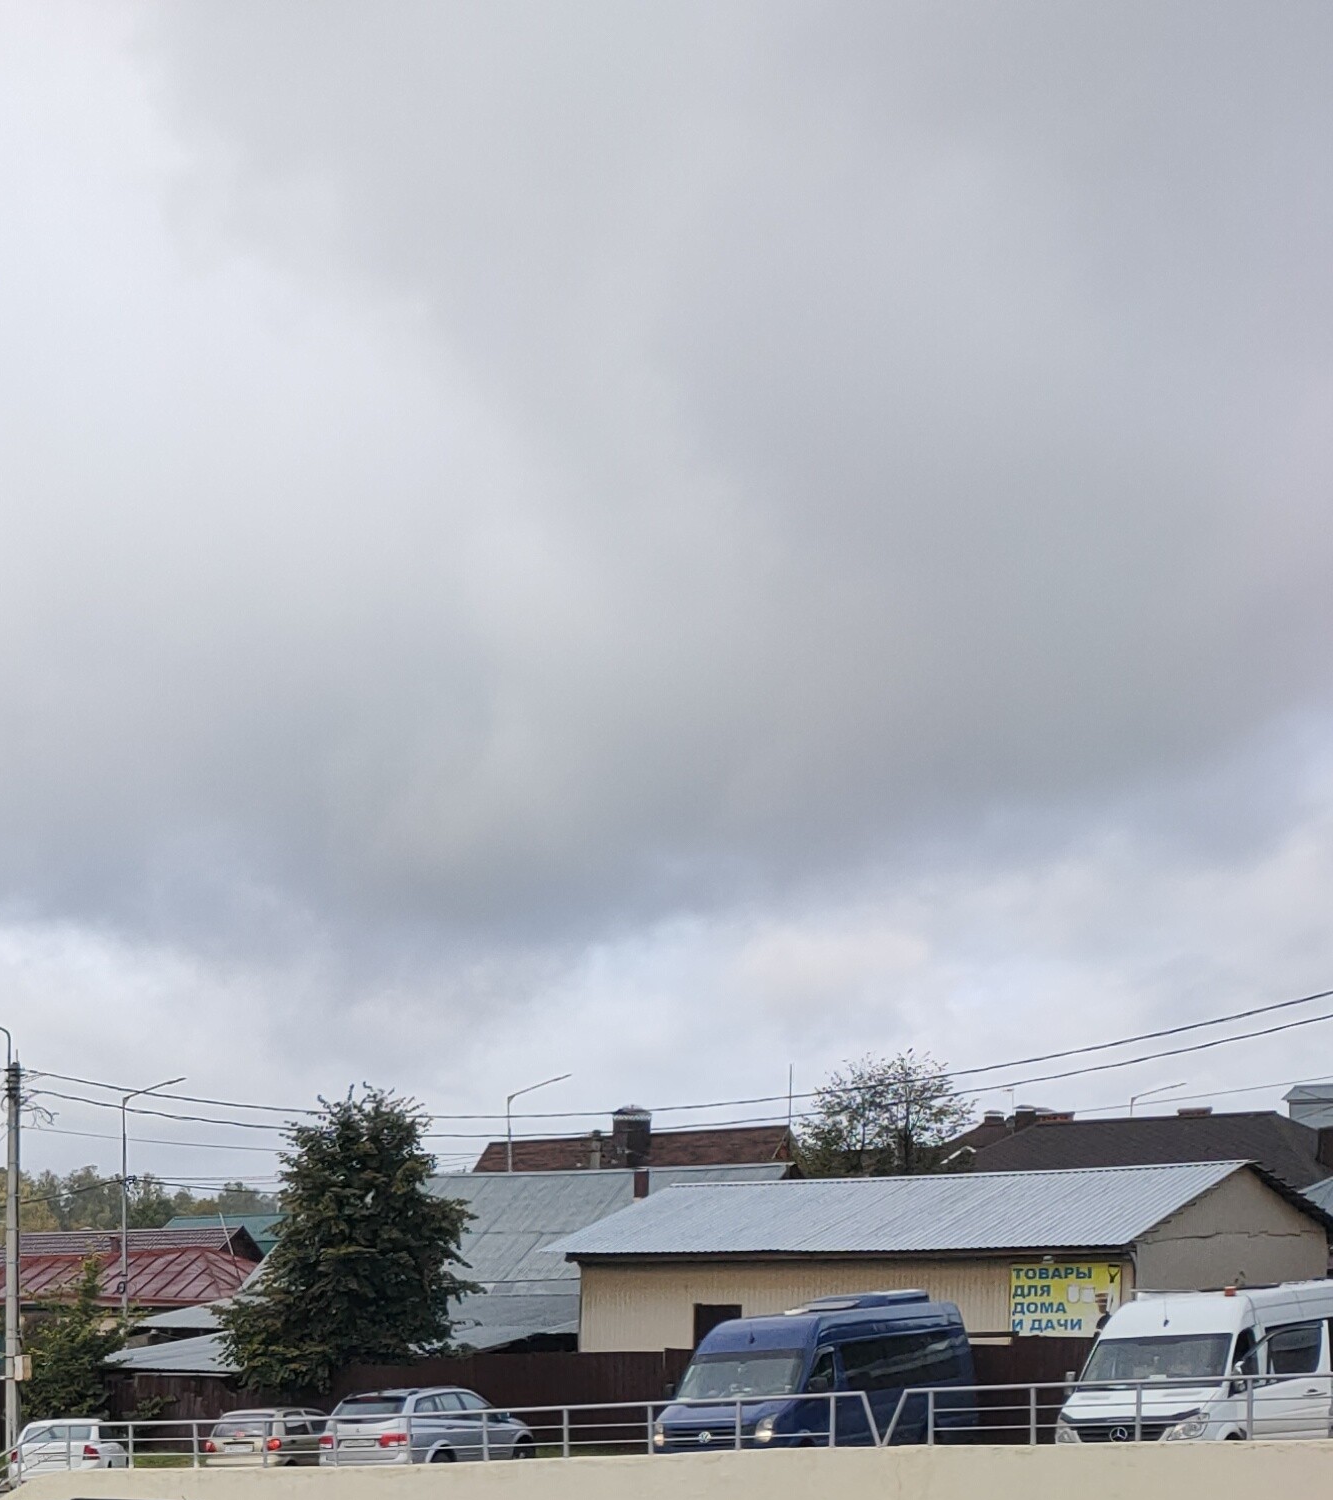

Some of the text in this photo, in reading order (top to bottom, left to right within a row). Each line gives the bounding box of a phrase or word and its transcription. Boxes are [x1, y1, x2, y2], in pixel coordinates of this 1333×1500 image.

[1013, 1267, 1092, 1280] ТОВАРЫ
[1012, 1284, 1051, 1299] ДЛЯ
[1012, 1302, 1067, 1316] ДОМА
[1012, 1318, 1083, 1333] И ДАЧИ
